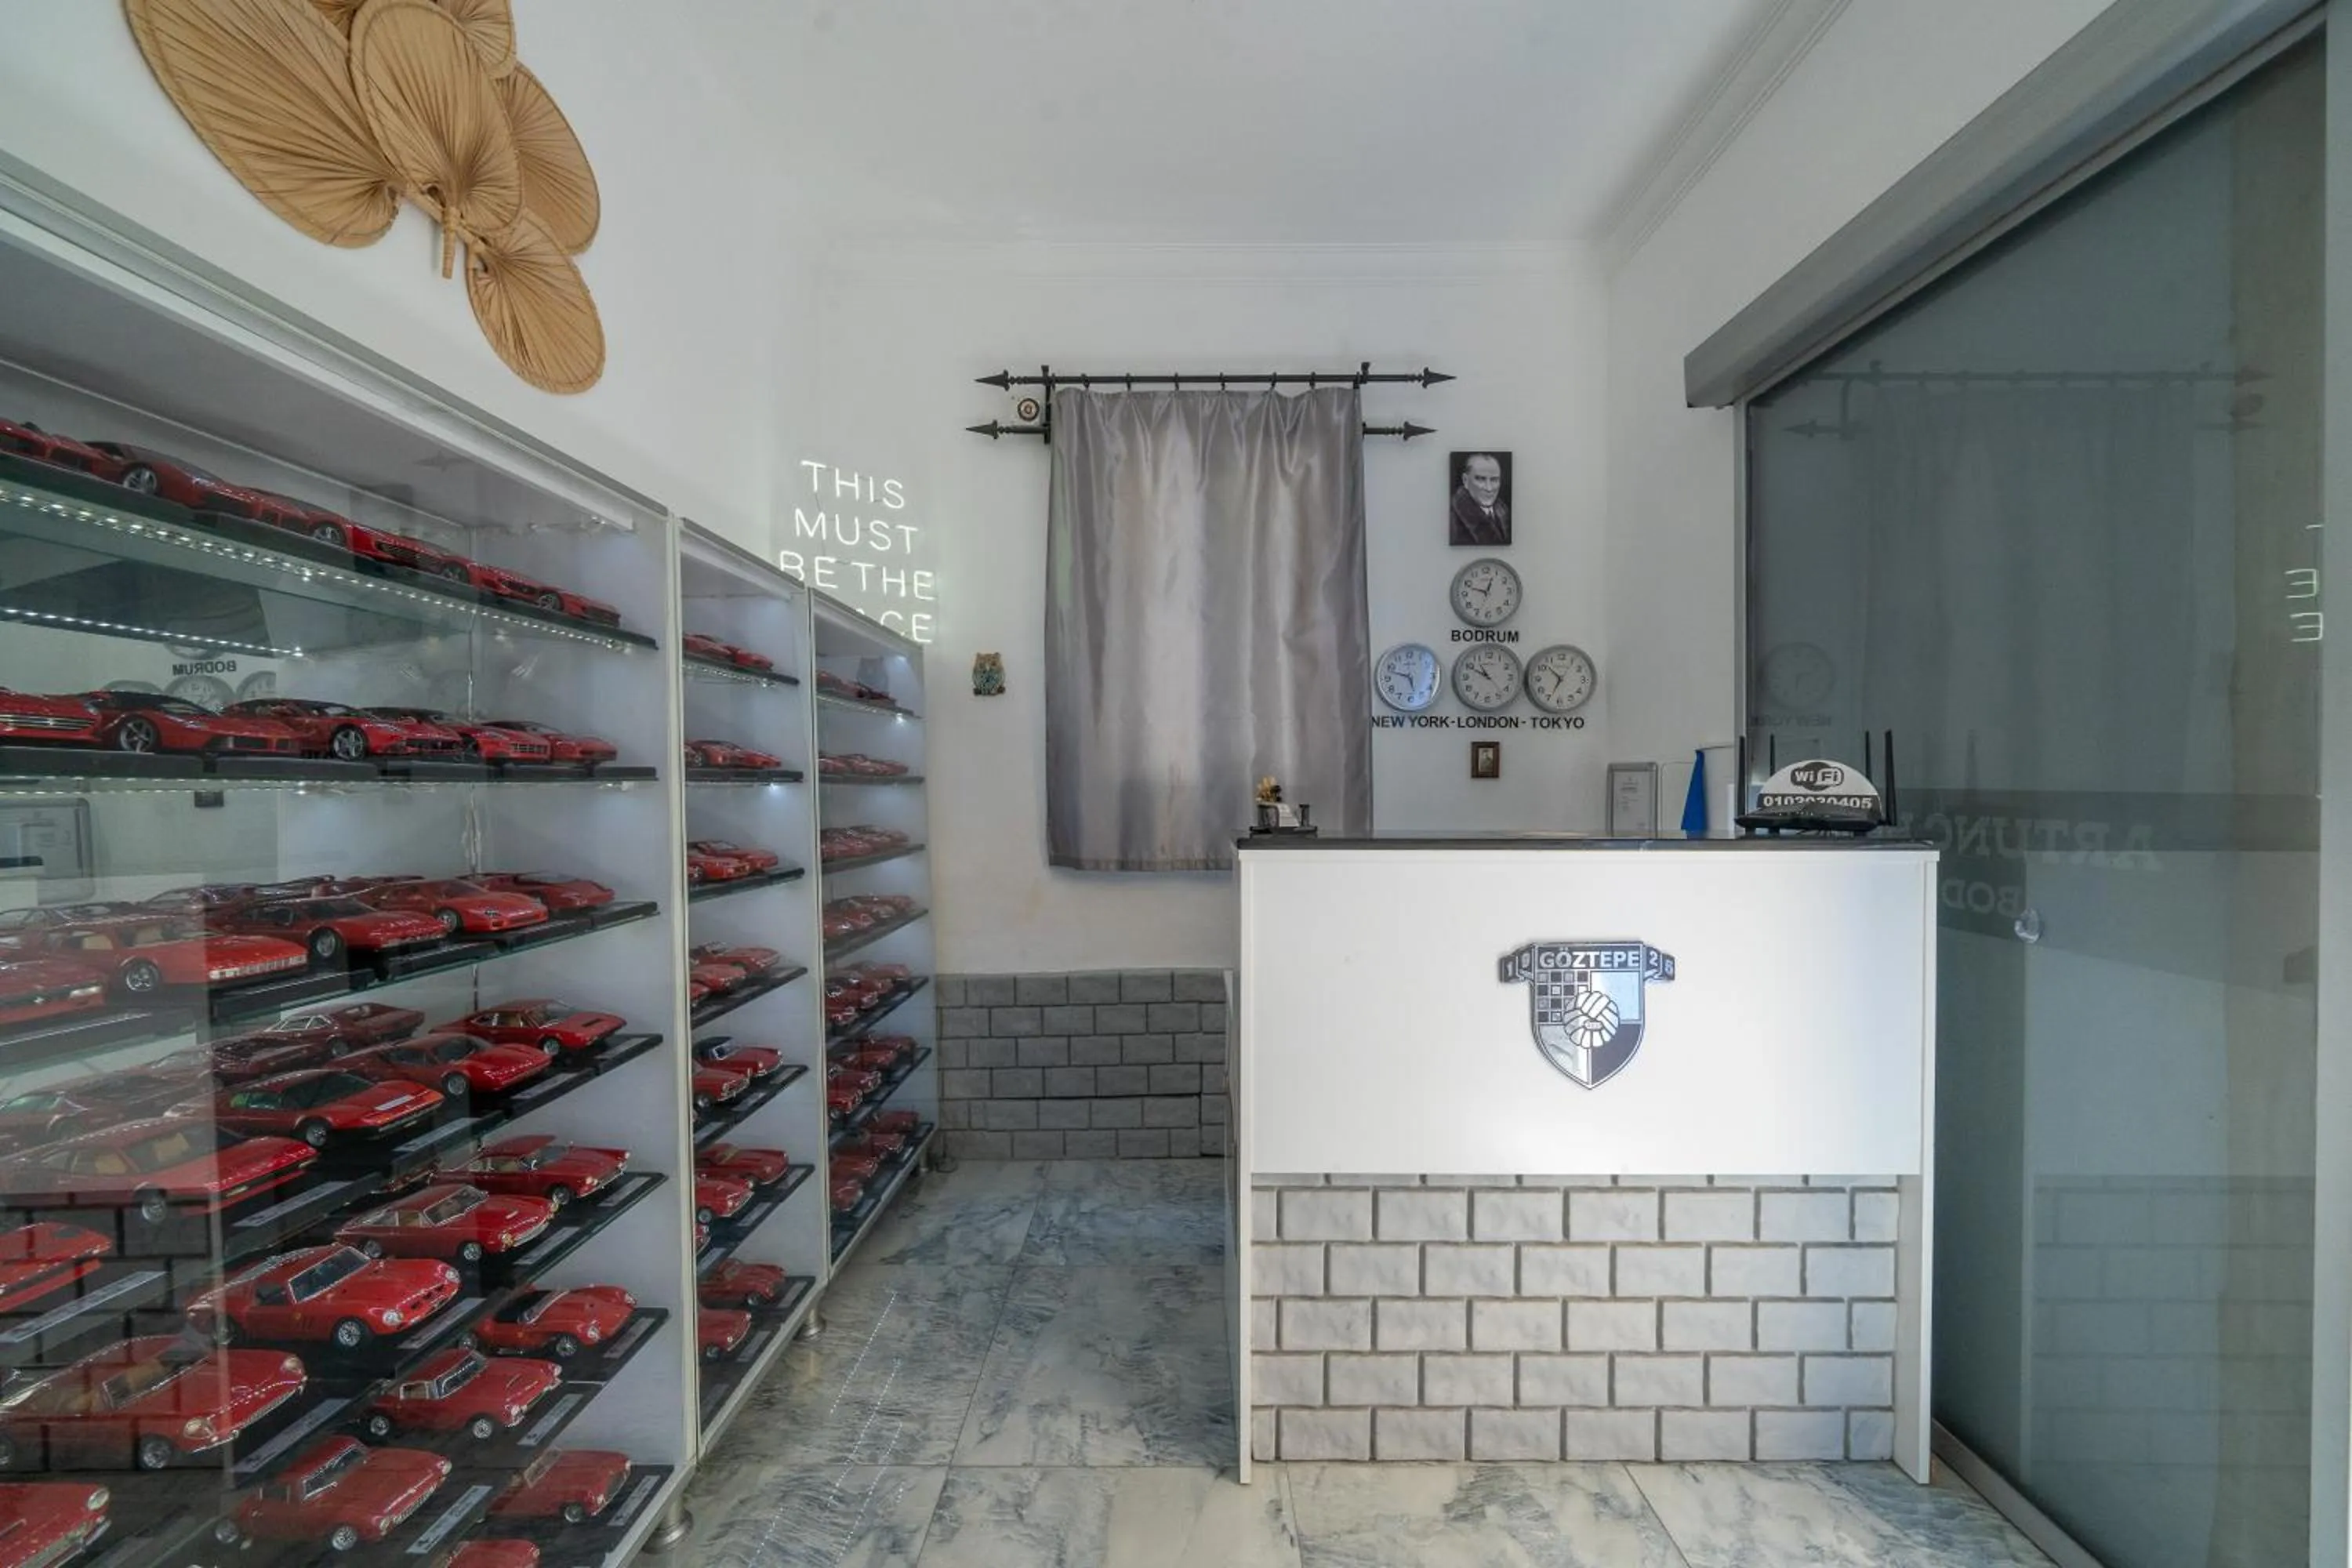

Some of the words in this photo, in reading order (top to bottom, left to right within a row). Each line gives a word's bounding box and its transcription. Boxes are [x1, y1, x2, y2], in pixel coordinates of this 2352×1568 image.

[800, 459, 906, 509] THIS
[794, 507, 919, 554] MUST
[779, 550, 839, 589] BE
[851, 561, 935, 601] THE
[1451, 630, 1519, 642] BODRUM
[1371, 716, 1405, 728] NEW
[1530, 716, 1584, 730] TOKYO
[1539, 947, 1640, 969] GÖZTEPE
